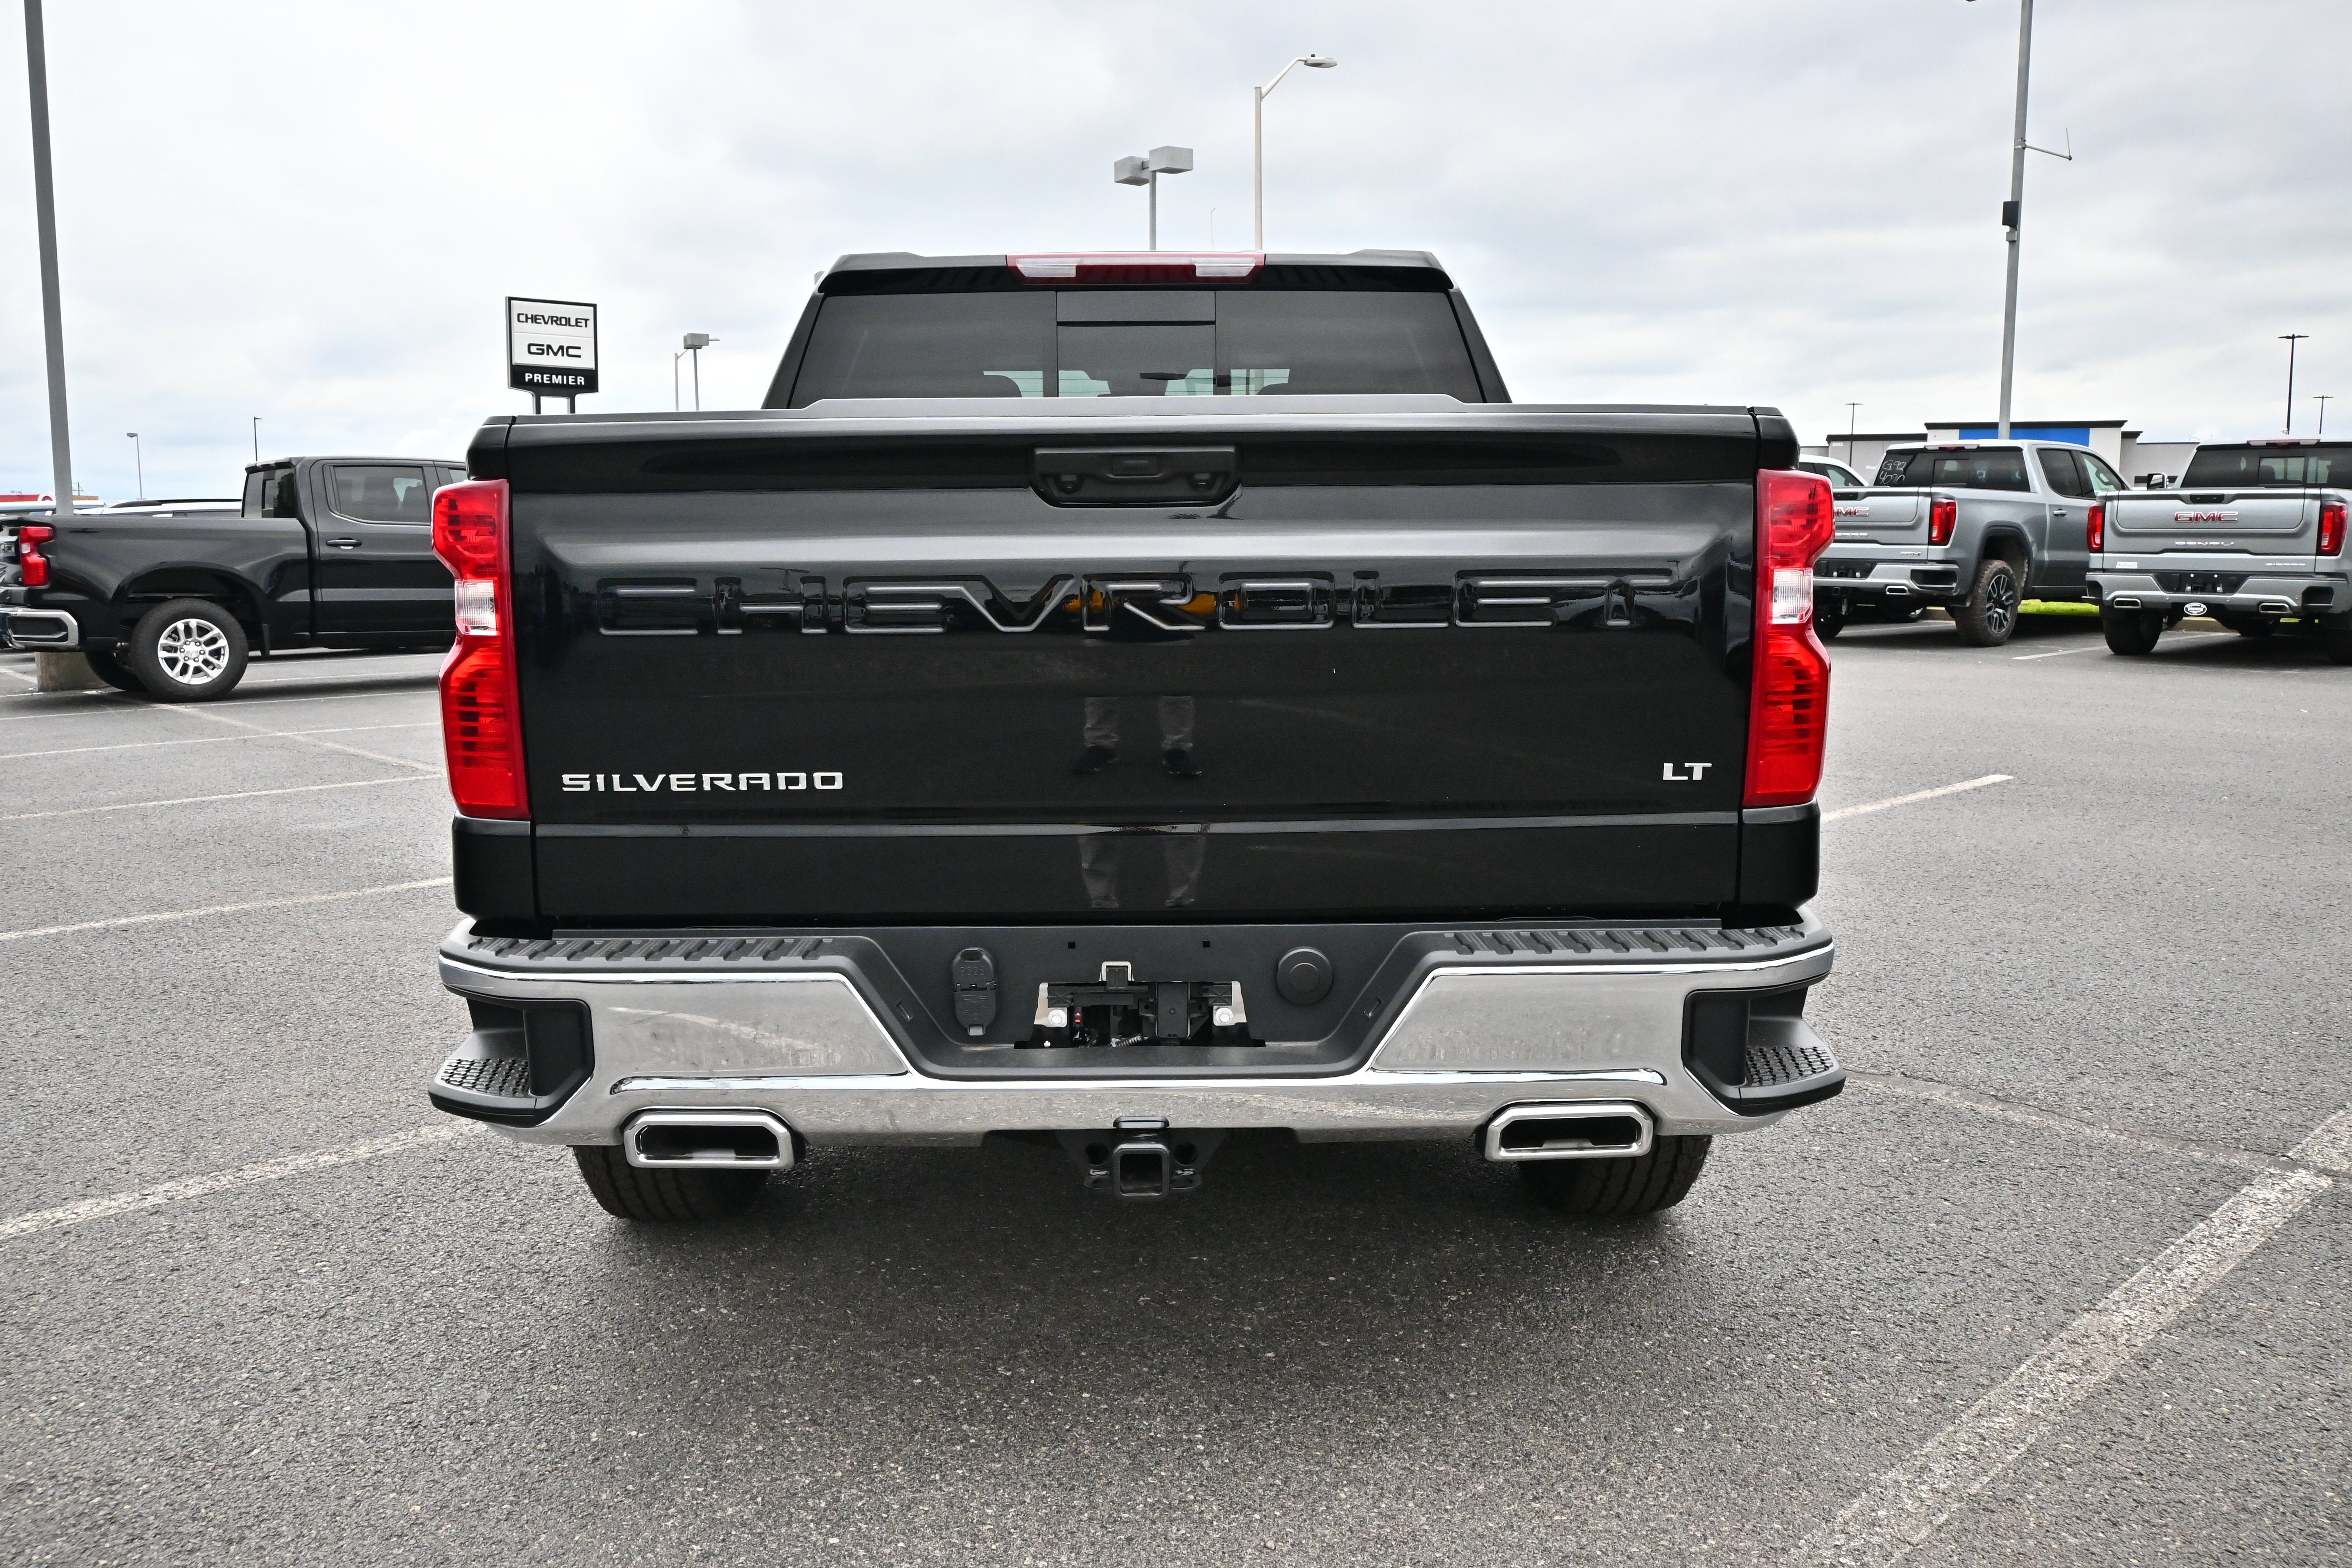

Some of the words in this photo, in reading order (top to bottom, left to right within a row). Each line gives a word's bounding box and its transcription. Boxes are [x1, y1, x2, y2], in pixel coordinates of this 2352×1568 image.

[517, 313, 590, 328] CHEVROLET
[527, 343, 582, 358] GMC
[525, 373, 585, 385] PREMIER
[1833, 506, 1870, 517] MC
[2175, 511, 2238, 523] GMC
[596, 568, 1674, 636] CHEVROLET
[1663, 762, 1712, 781] LT
[561, 772, 844, 792] SILVERADO
